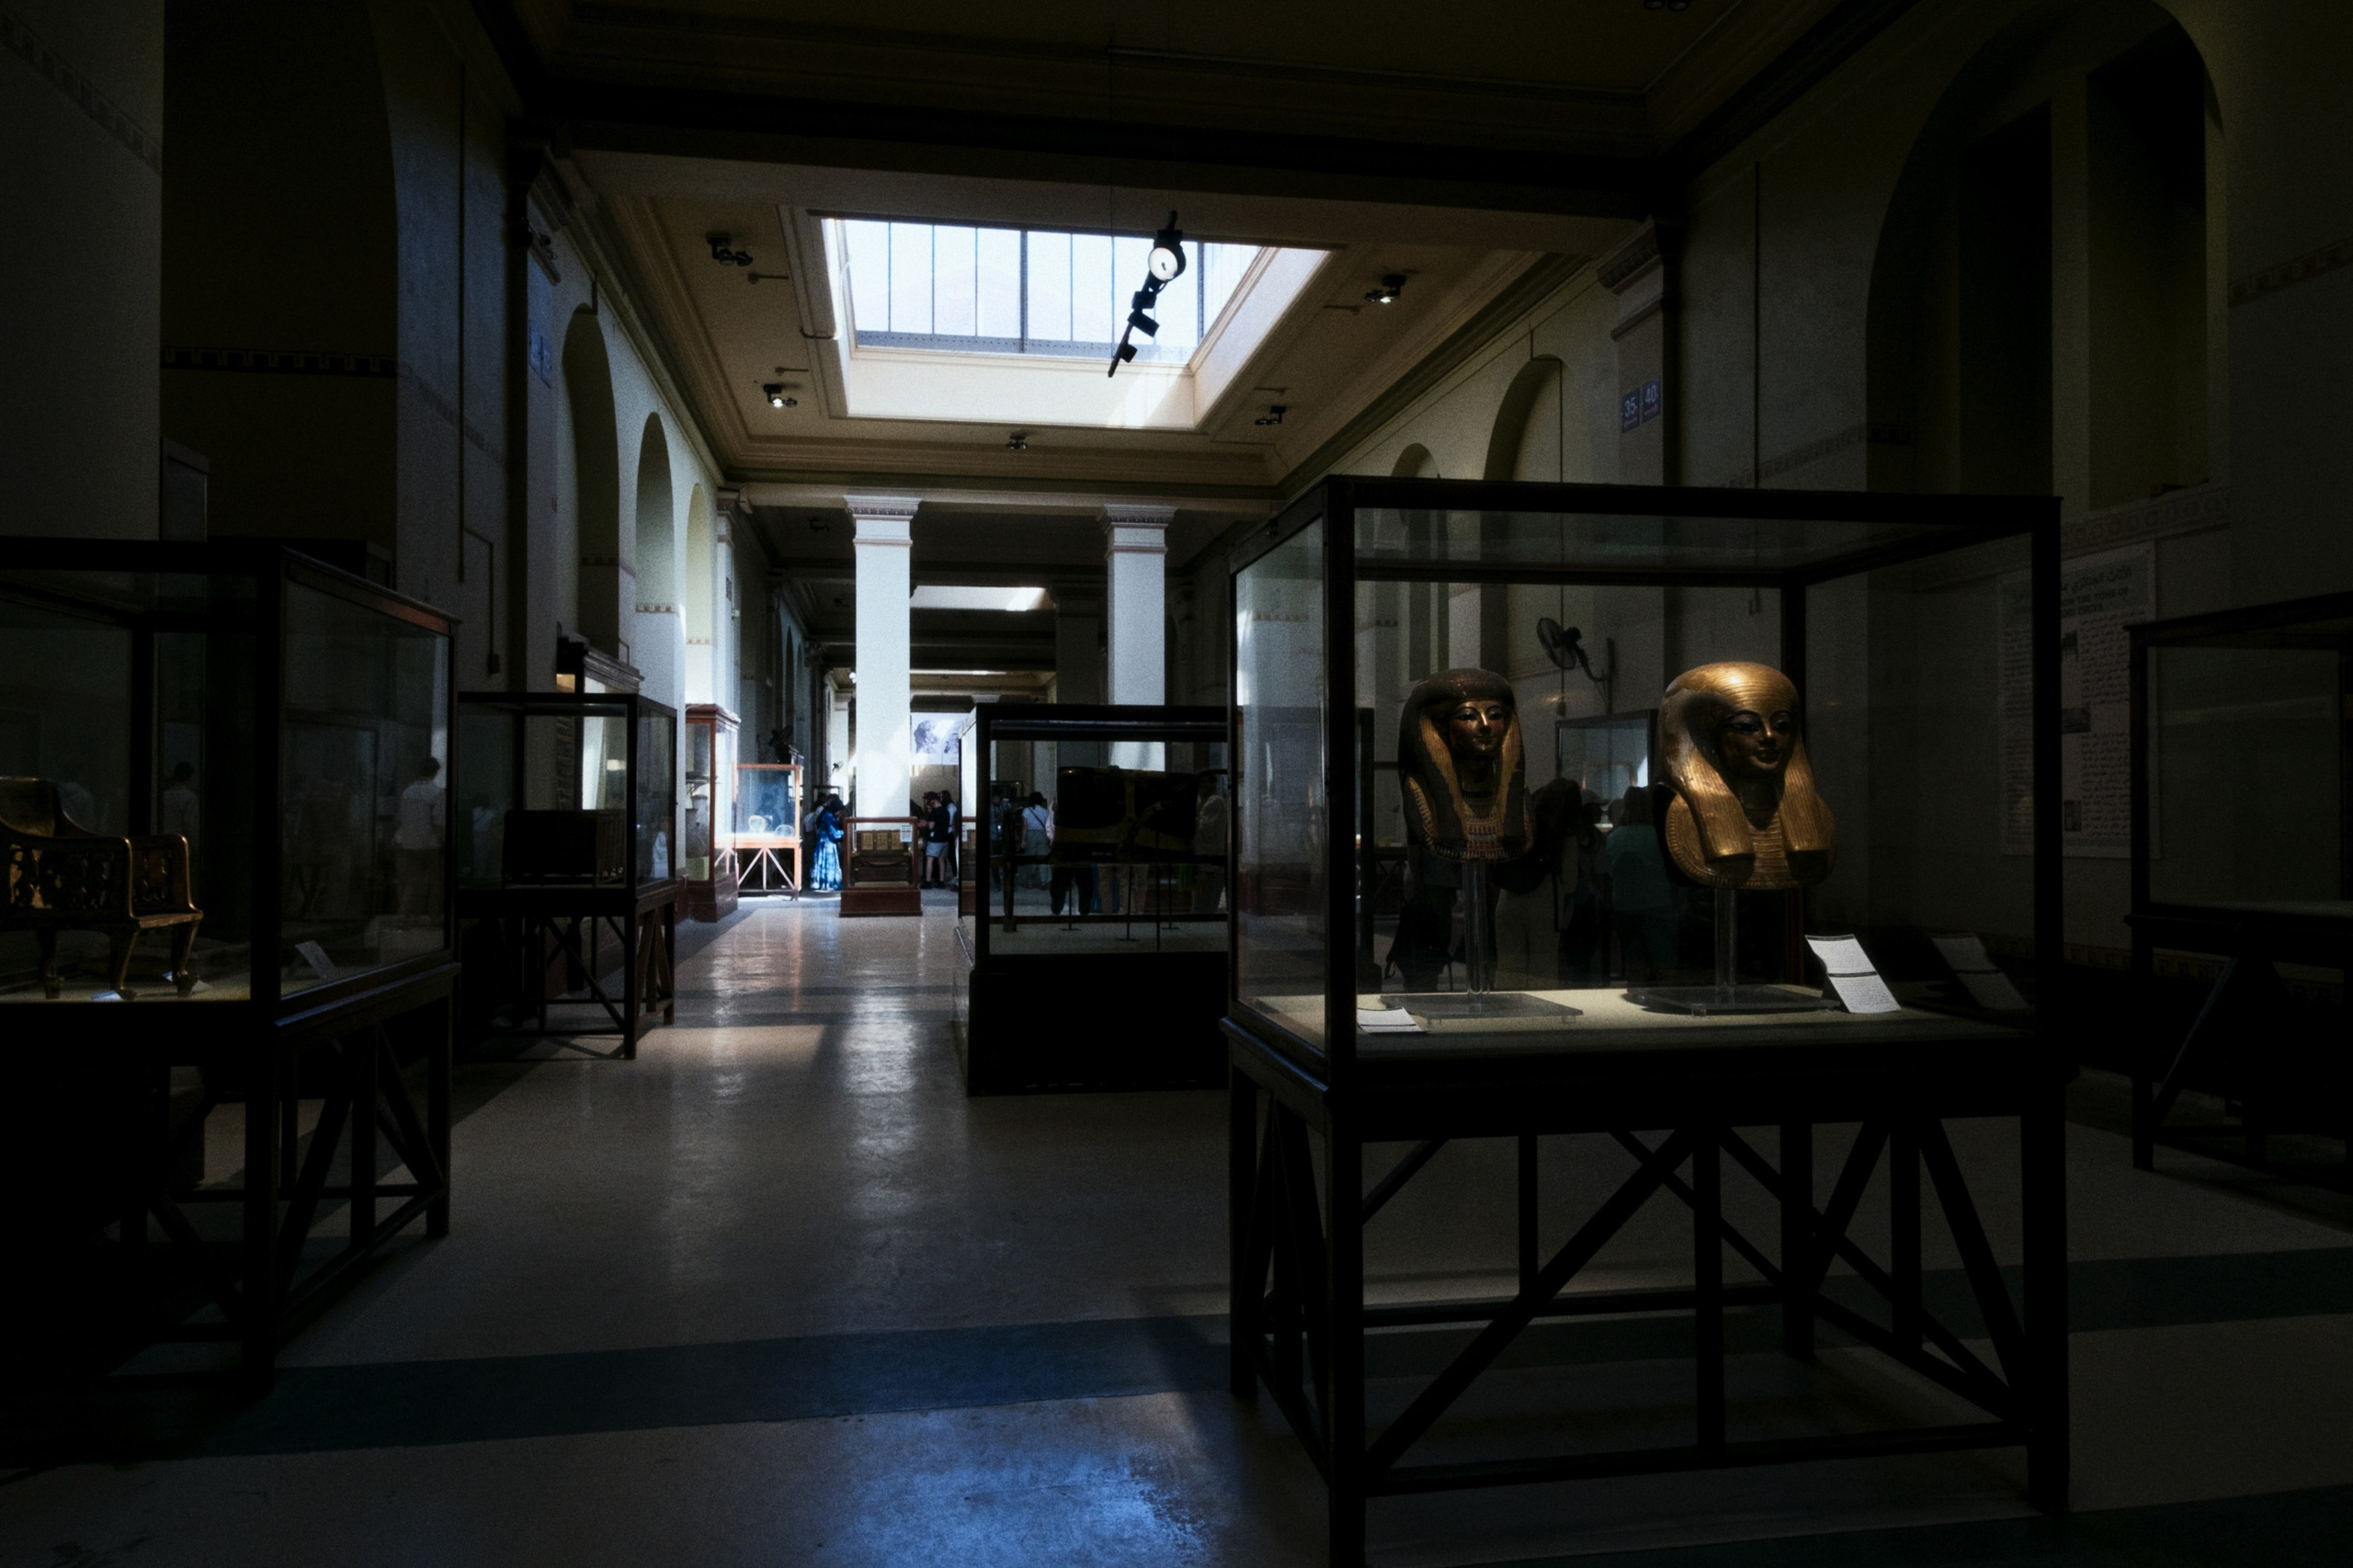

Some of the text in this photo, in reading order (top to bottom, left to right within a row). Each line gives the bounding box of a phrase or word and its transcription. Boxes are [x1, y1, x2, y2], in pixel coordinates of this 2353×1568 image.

[1644, 384, 1656, 404] 40
[1624, 396, 1636, 417] 35
[2076, 595, 2091, 603] THE
